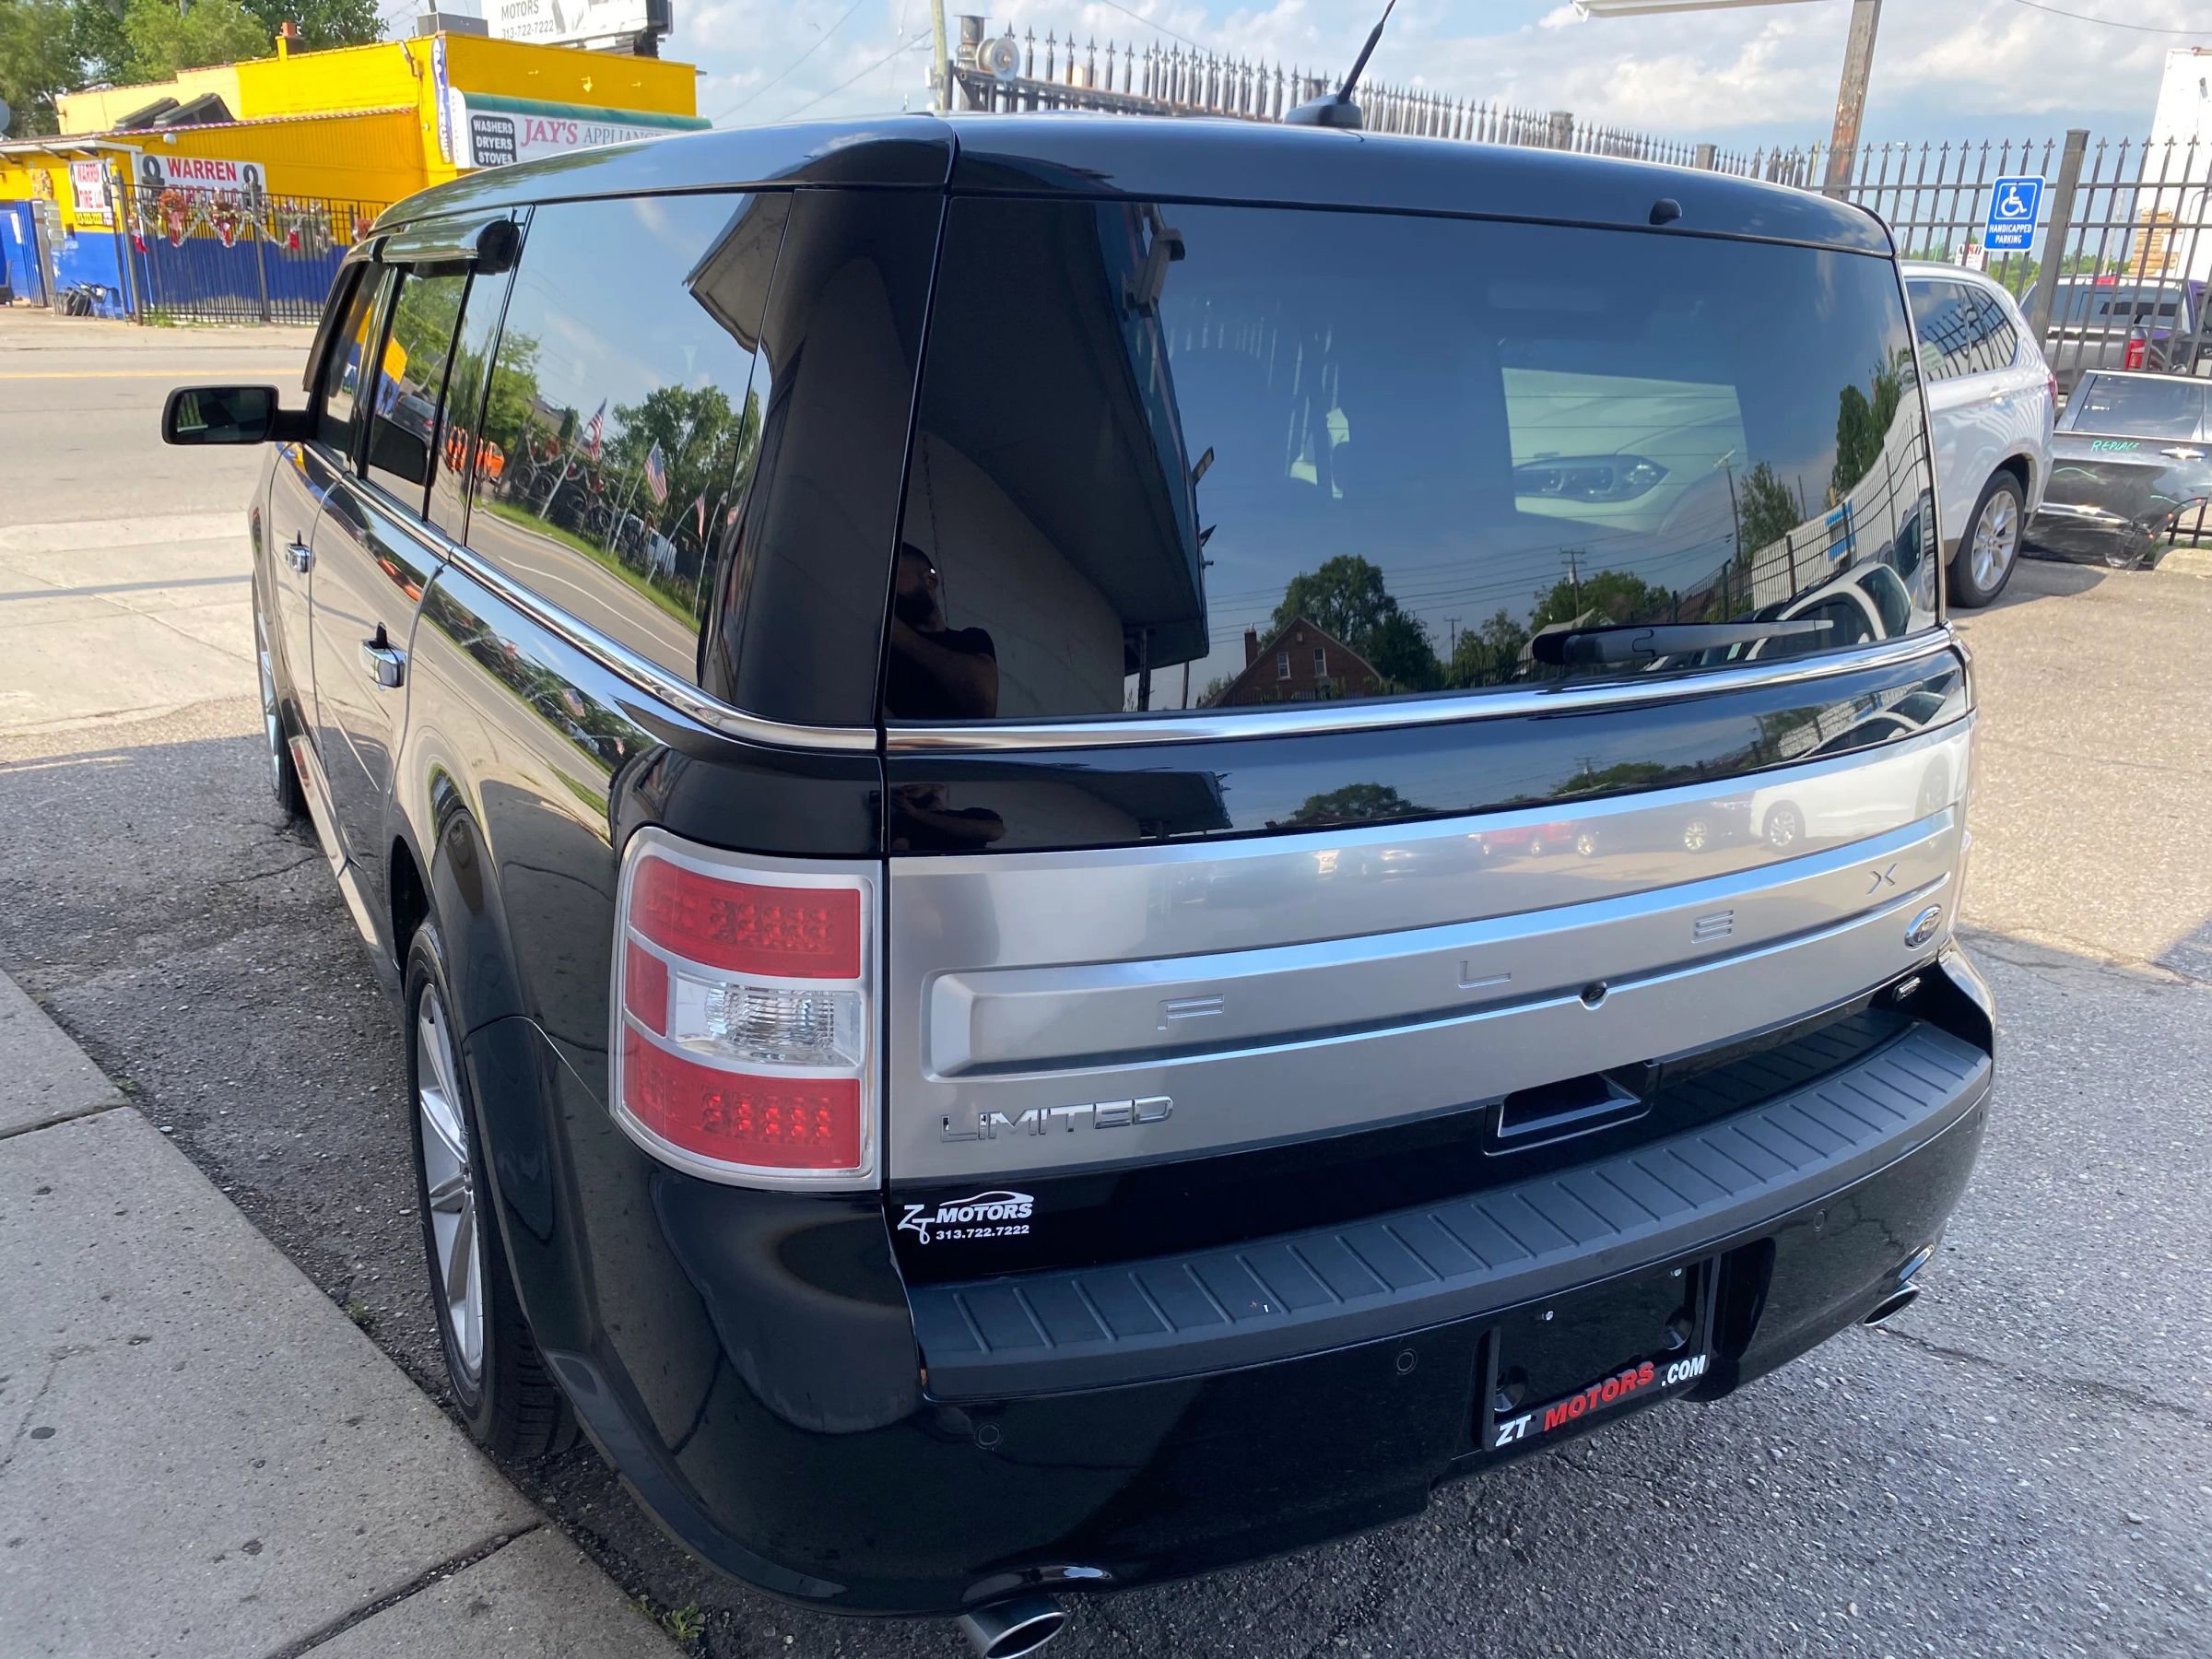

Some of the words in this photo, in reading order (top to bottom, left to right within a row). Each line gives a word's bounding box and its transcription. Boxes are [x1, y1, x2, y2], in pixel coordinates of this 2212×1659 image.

[501, 0, 539, 20] MOTORS
[473, 119, 513, 135] WASHERS
[521, 118, 578, 147] JAY'S
[476, 135, 513, 150] DRYERS
[478, 151, 513, 165] STOVES
[167, 158, 237, 182] WARREN
[1989, 224, 2032, 234] HANDICAPPED
[1994, 234, 2022, 244] PARKING
[940, 1095, 1173, 1143] LIMITED
[935, 1202, 1033, 1224] MOTORS
[935, 1225, 1030, 1241] 313.722.7222
[1495, 1415, 1532, 1447] ZT
[1544, 1361, 1654, 1431] MOTORS
